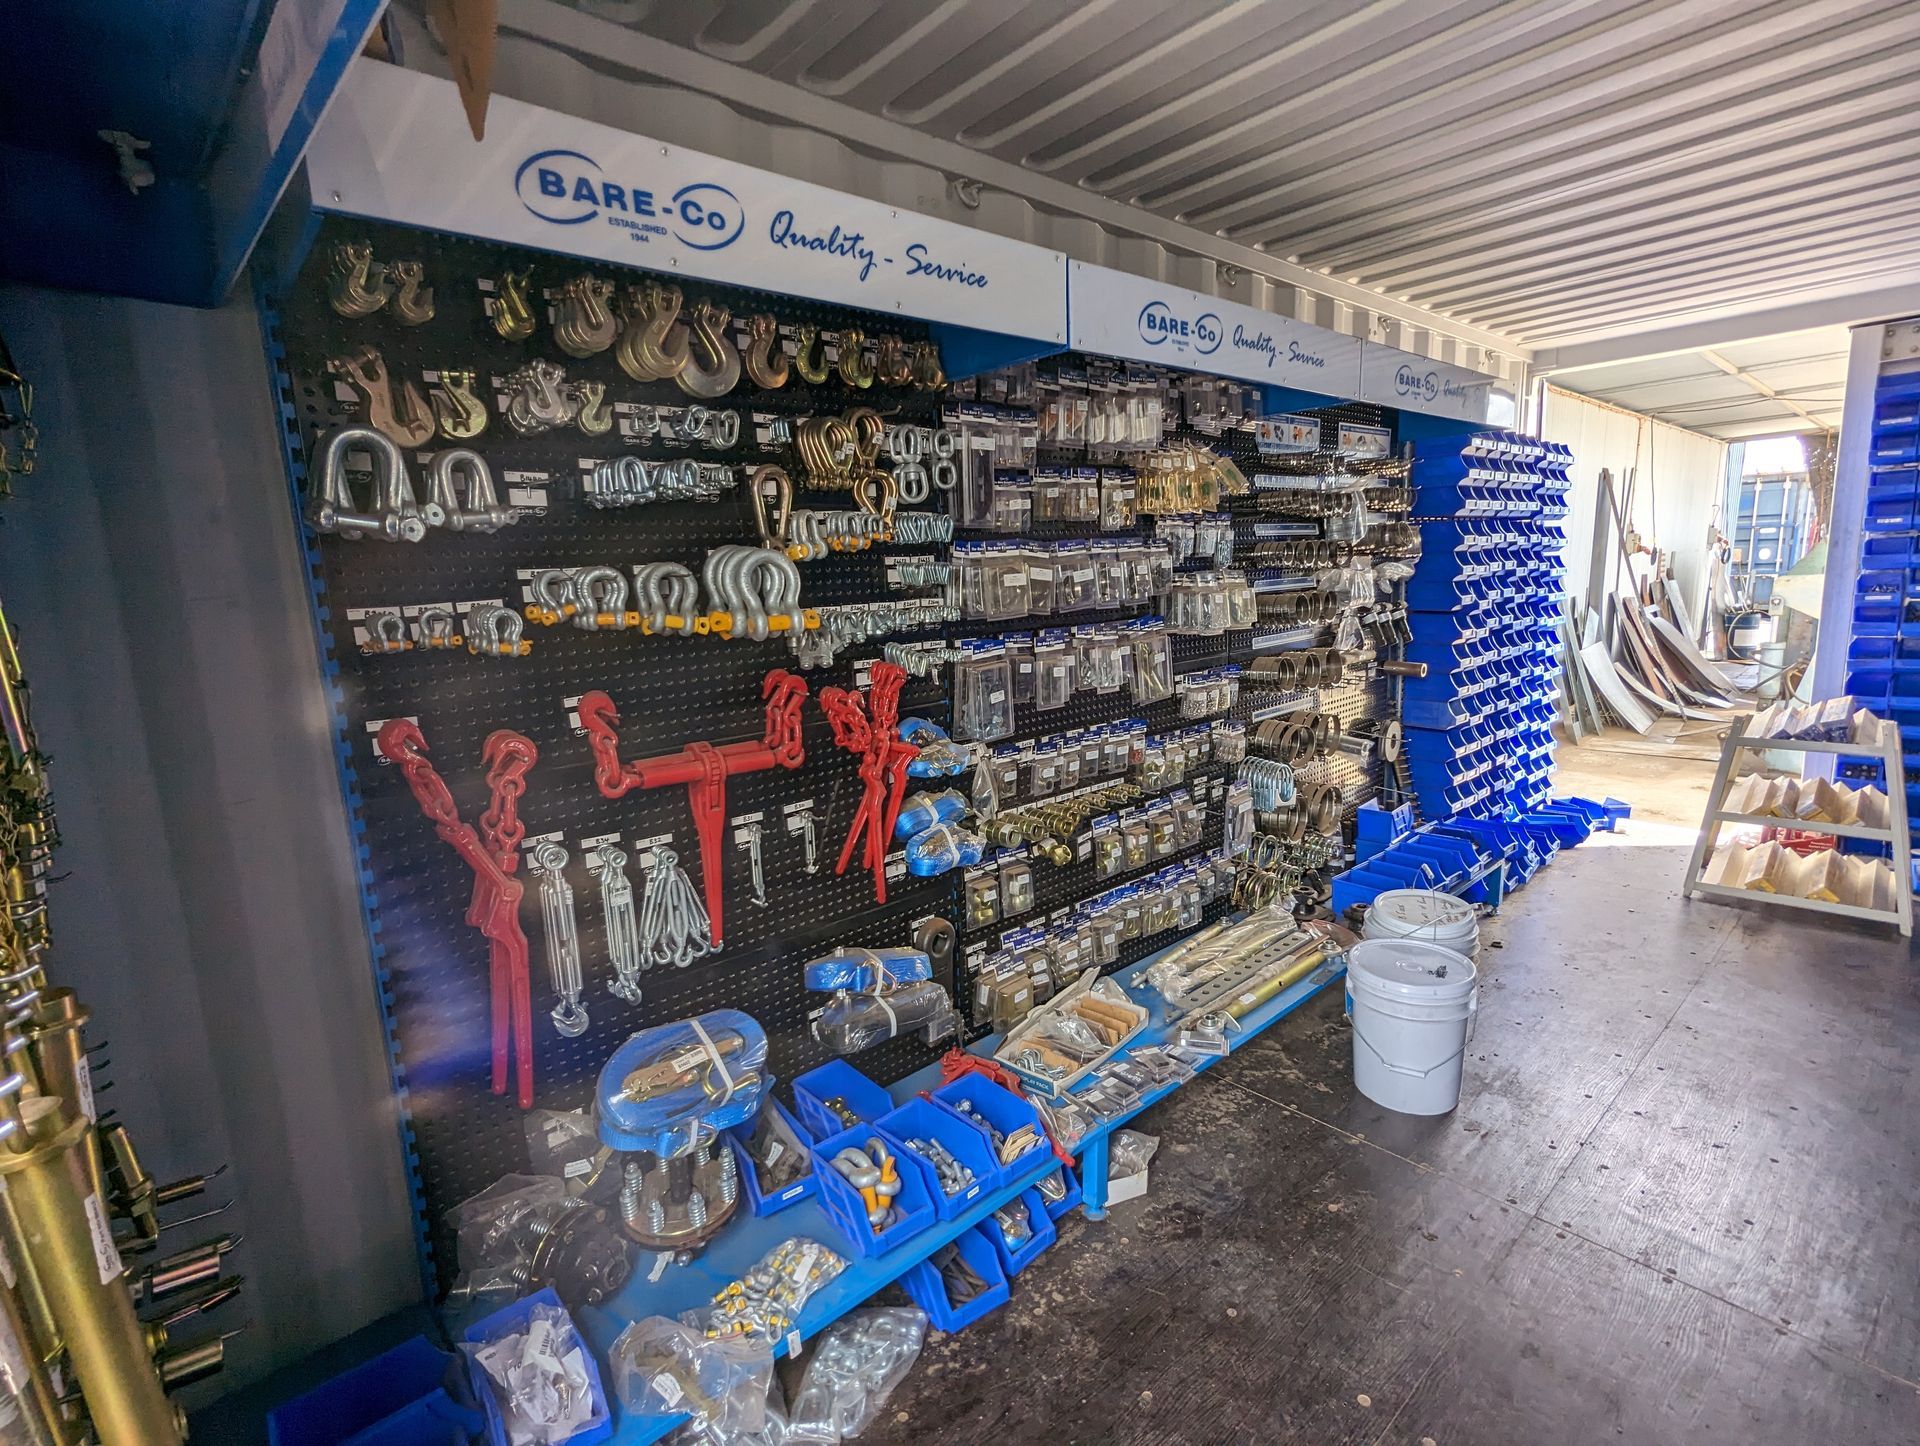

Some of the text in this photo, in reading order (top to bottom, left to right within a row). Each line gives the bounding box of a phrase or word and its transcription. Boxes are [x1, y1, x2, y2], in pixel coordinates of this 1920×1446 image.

[538, 167, 727, 231] BARE-Co
[608, 216, 668, 236] ESTABLISHED
[630, 232, 650, 243] 1944
[769, 210, 877, 282] Quality
[905, 243, 988, 288] Service
[1147, 312, 1216, 342] BARE-Co
[1232, 324, 1277, 368] Quality
[1287, 340, 1325, 369] Service
[1399, 373, 1435, 393] BARE-Co
